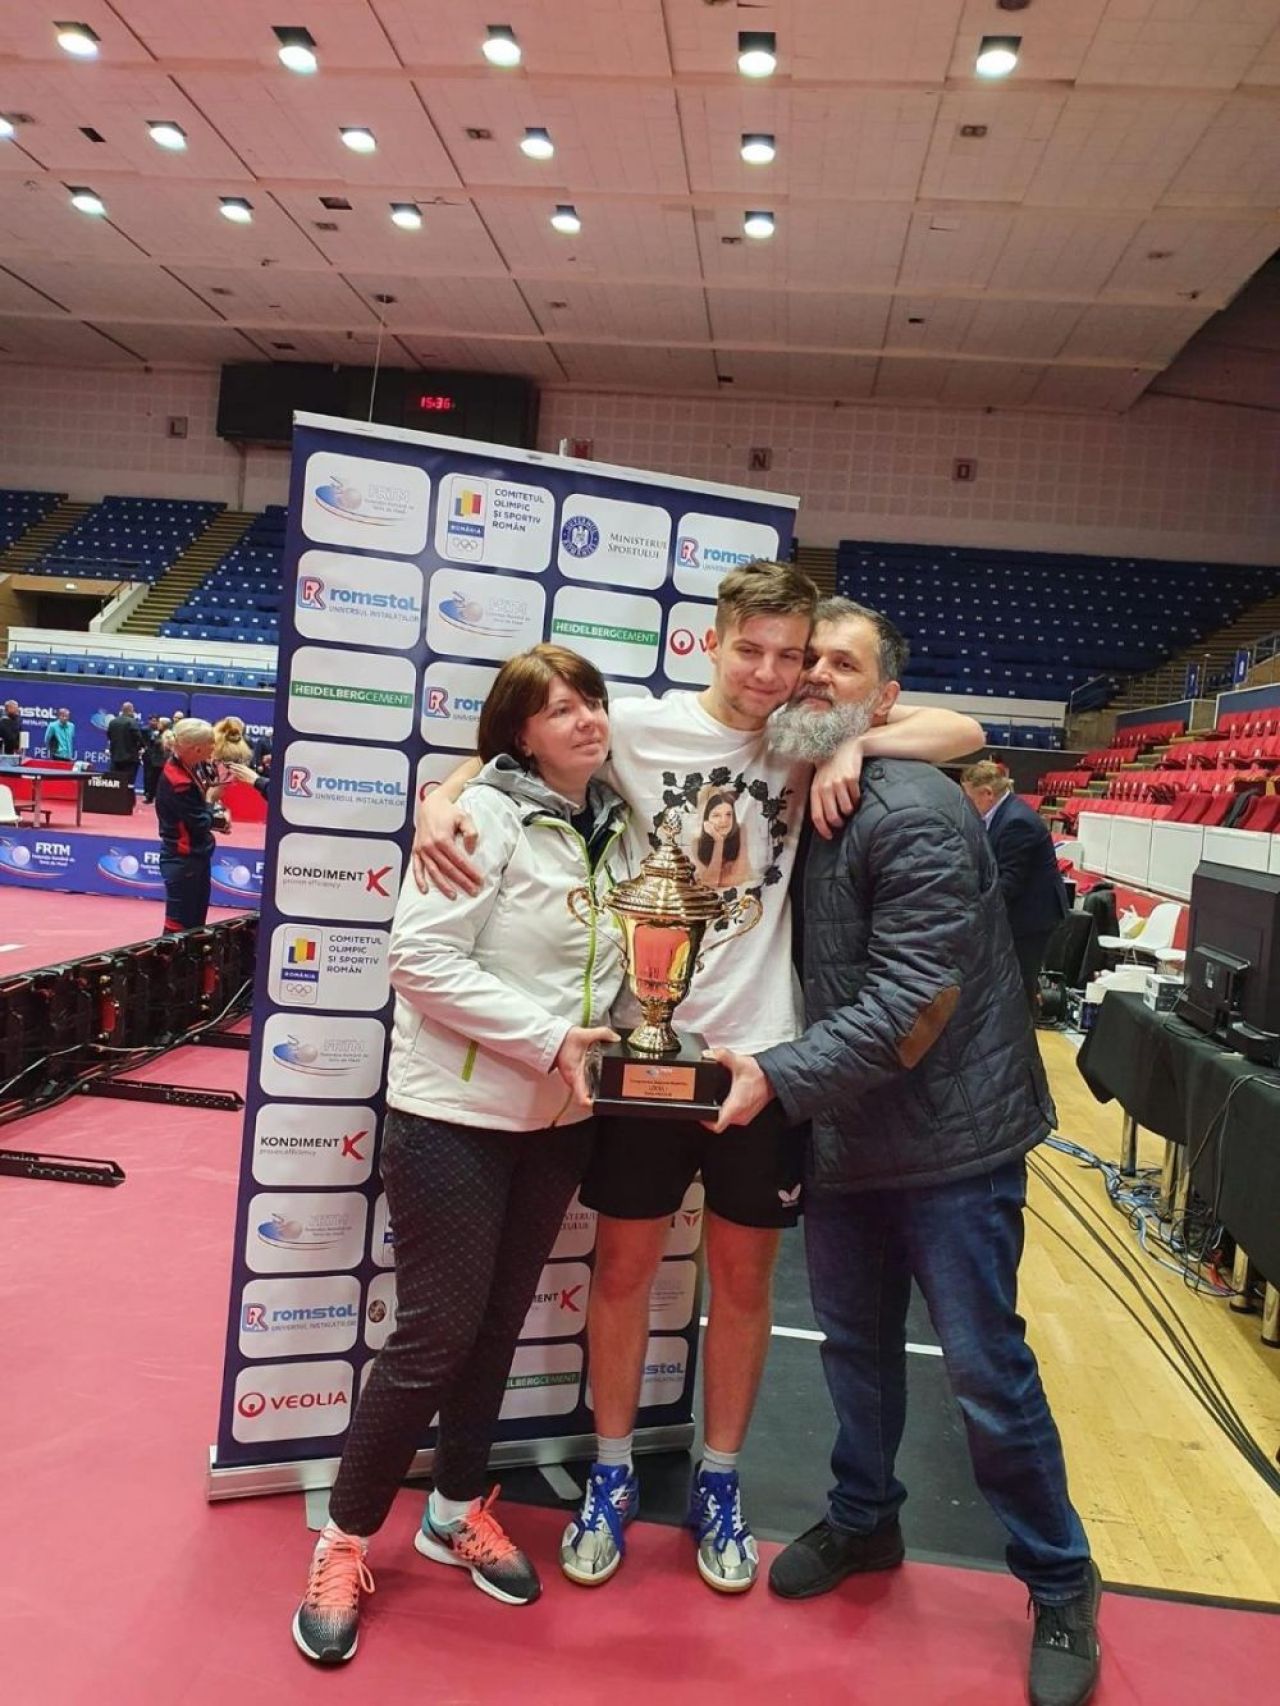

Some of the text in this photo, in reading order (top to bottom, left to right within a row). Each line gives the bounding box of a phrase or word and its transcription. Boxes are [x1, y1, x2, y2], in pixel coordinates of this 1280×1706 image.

[495, 488, 544, 503] COMITETUL
[494, 499, 531, 512] OLIMPIC
[504, 511, 541, 524] SPORTIV
[608, 532, 667, 549] MINISTERUL
[607, 543, 659, 559] SPORTULUI
[556, 621, 656, 643] HEIDELBERGCEMENT
[295, 683, 409, 705] HEIDELBERGCEMENT
[35, 841, 70, 856] FRTM
[283, 865, 364, 881] KONDIMENT
[329, 934, 383, 945] COMITETUL
[328, 945, 367, 954] OLIMPIC
[340, 955, 379, 964] SPORTIV
[260, 1136, 340, 1148] KONDIMENT
[271, 1391, 347, 1410] VEOLIA
